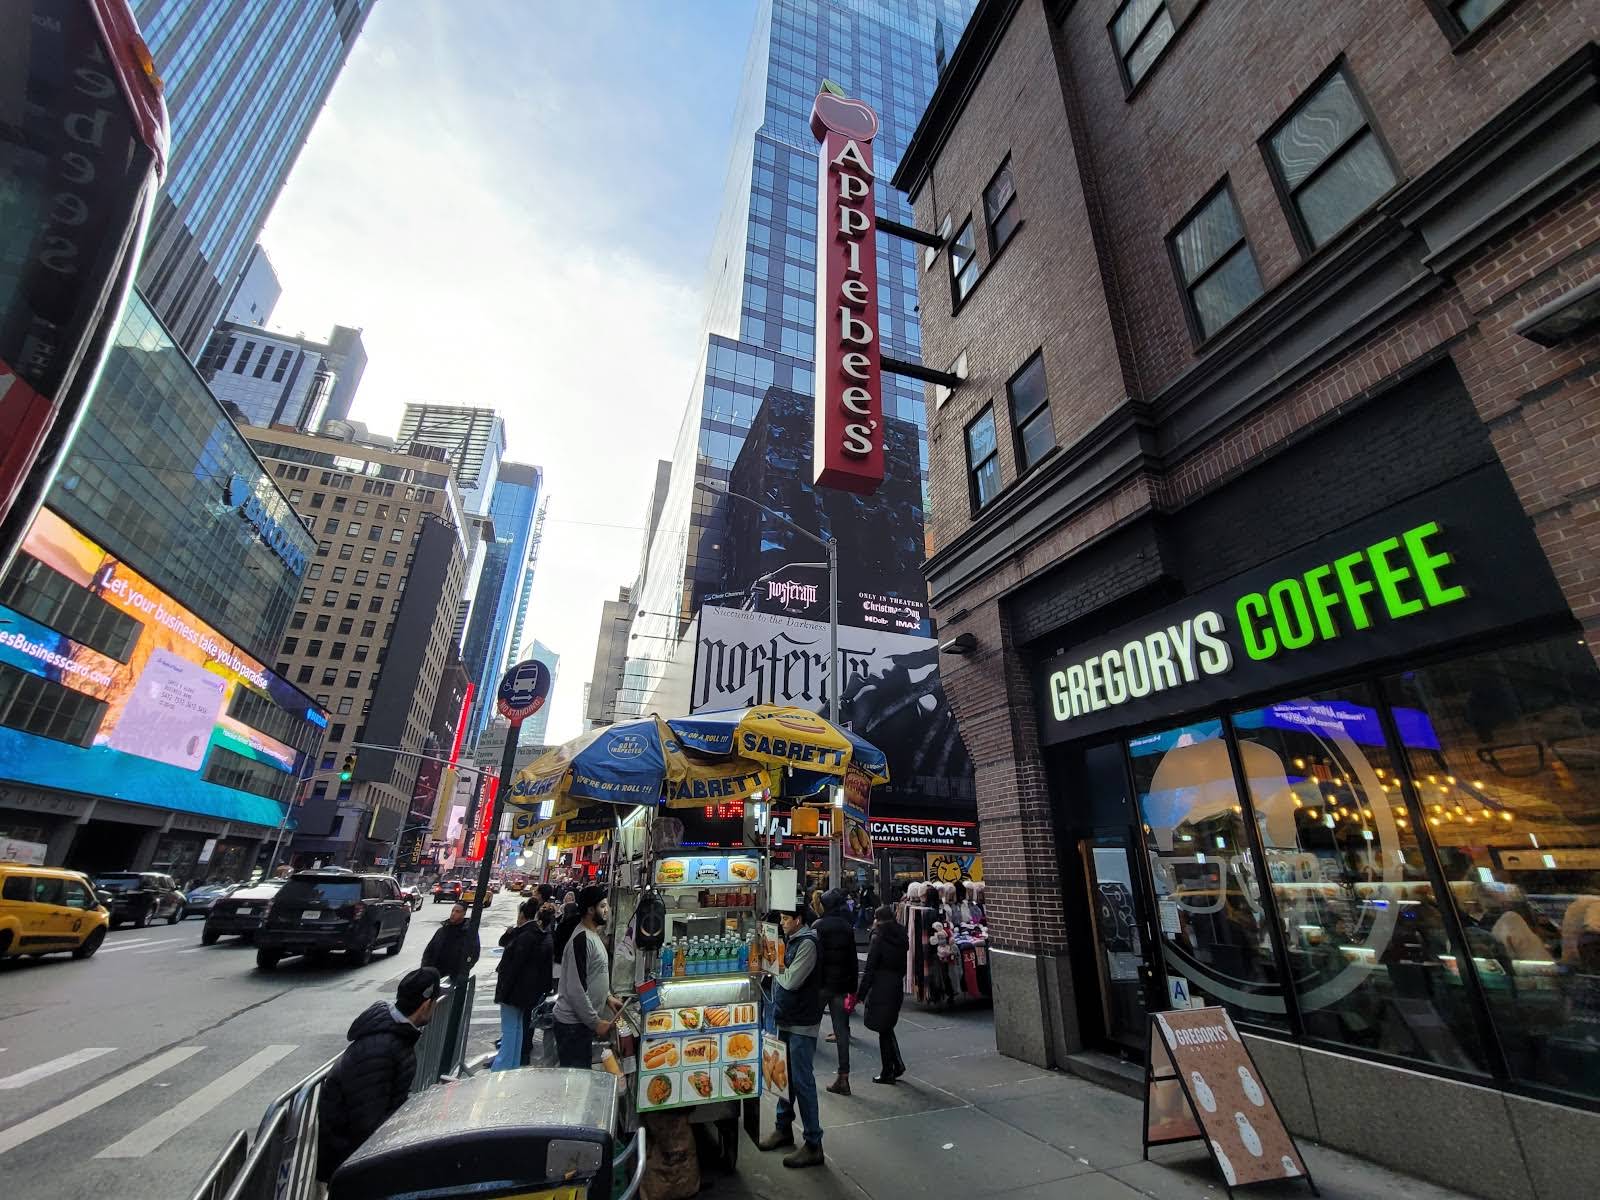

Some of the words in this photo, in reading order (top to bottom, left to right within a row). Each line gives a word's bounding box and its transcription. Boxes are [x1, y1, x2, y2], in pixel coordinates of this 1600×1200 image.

[831, 140, 877, 454] Applebee's
[859, 592, 876, 600] ONLY
[889, 597, 923, 608] THEATERS
[101, 567, 128, 597] Let
[124, 590, 157, 614] your
[155, 605, 200, 643] business
[199, 635, 218, 657] take
[216, 645, 233, 666] you
[231, 657, 240, 671] to
[240, 662, 268, 690] paradise
[713, 607, 755, 621] Succumb
[758, 614, 767, 622] to
[769, 615, 783, 626] the
[786, 617, 827, 632] Darkness
[896, 620, 920, 630] IMAX
[1049, 610, 1232, 721] GREGORYS
[1237, 521, 1466, 660] COFFEE
[0, 629, 111, 687] esBusinesscard.com
[508, 697, 541, 717] STANDING
[688, 732, 698, 740] ON
[704, 735, 720, 743] ROLL
[611, 746, 642, 754] INSPECTED
[743, 732, 846, 767] SABRETT
[577, 775, 600, 788] WE'RE
[601, 782, 614, 791] ON
[621, 784, 640, 793] ROLL
[641, 786, 653, 794] !!!
[668, 772, 761, 800] SABRETT
[937, 826, 966, 837] CAFE
[1174, 981, 1187, 1001] A
[1175, 1025, 1228, 1046] GREGORYS
